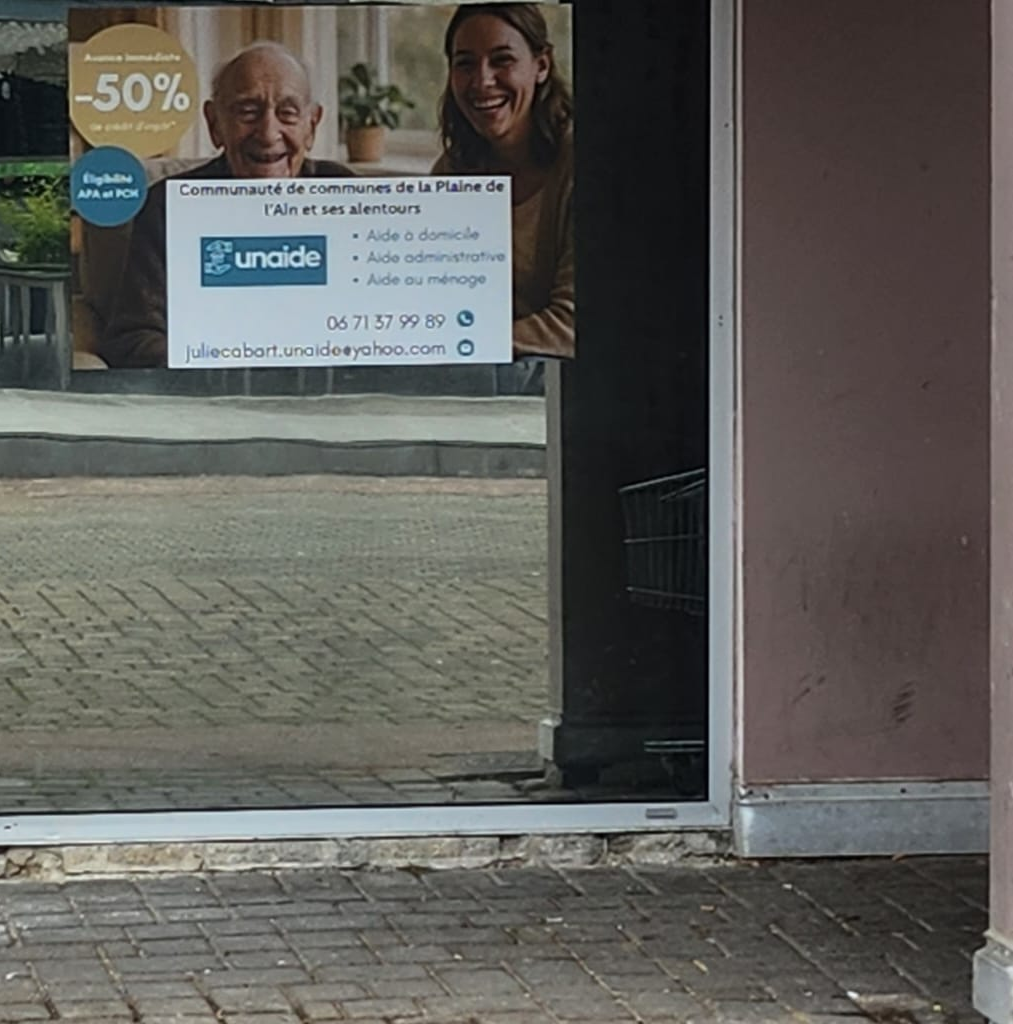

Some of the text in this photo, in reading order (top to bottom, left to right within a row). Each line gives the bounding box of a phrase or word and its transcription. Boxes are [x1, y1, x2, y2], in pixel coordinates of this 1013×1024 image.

[75, 72, 190, 112] -50%
[77, 188, 101, 199] APA
[179, 179, 505, 196] Communauté de communes de la Plaine de
[264, 202, 421, 216] l'Ain et ses alentours
[366, 226, 480, 242] Aide à domicile
[234, 244, 321, 269] unaide
[366, 250, 506, 264] Aide administrative
[366, 273, 487, 289] Aide au ménage
[326, 314, 446, 331] 06 71 37 99 89
